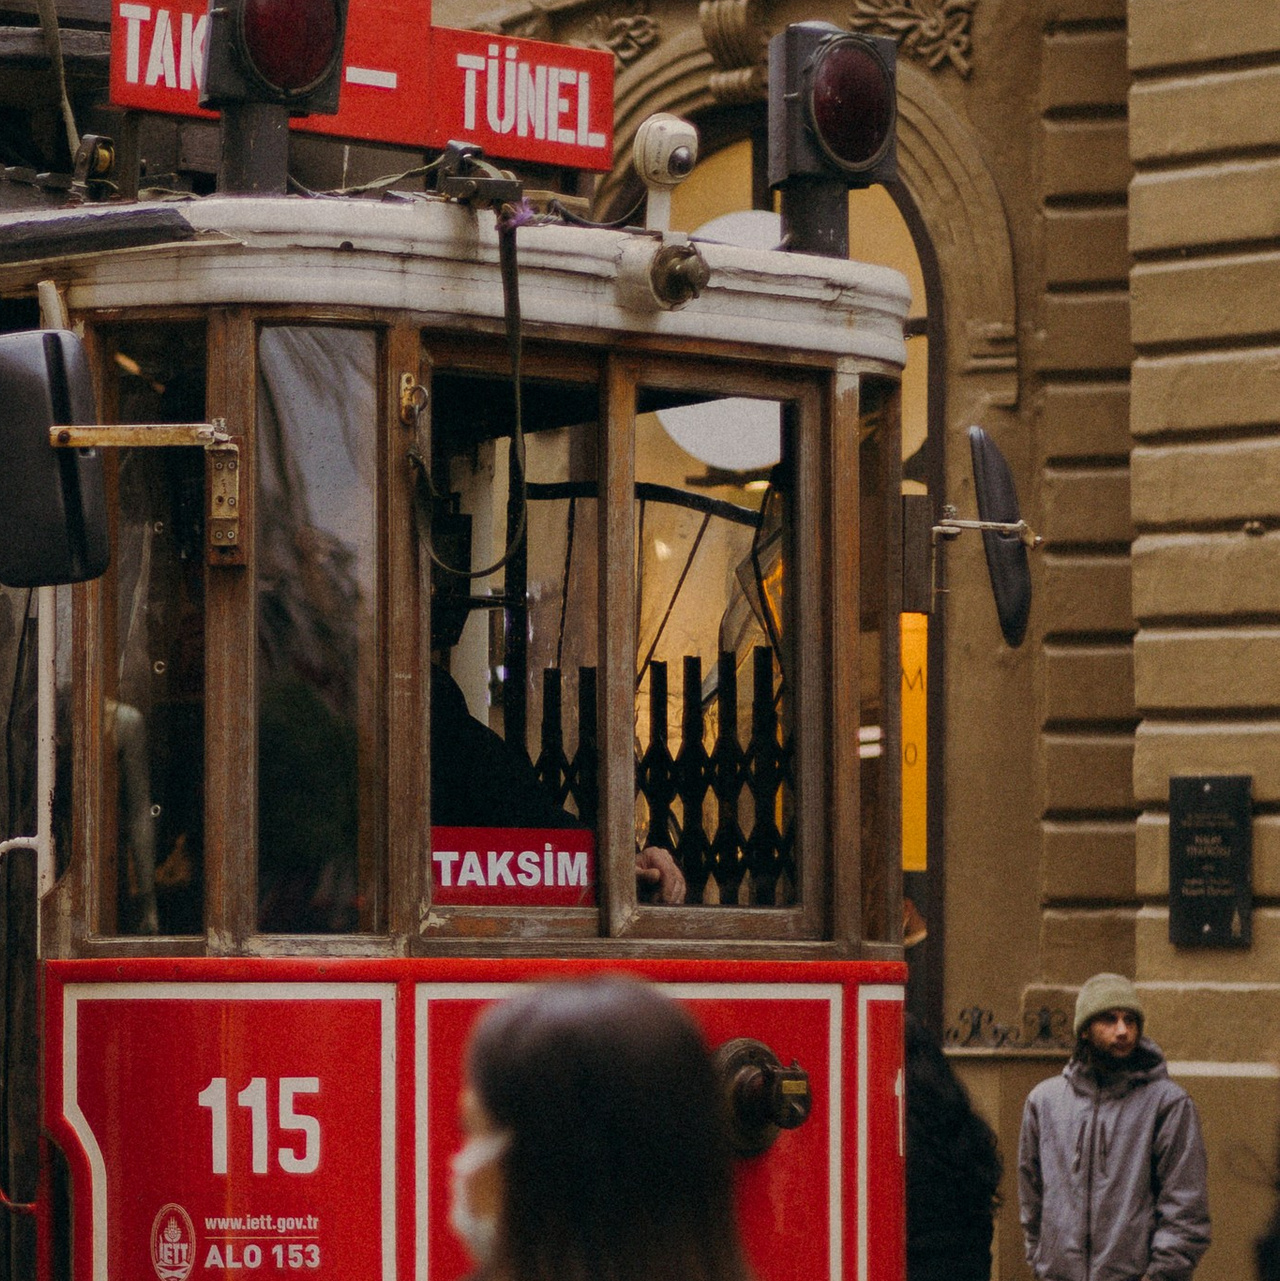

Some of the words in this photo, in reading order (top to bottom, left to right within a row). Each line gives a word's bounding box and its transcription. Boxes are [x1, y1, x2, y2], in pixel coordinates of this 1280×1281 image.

[119, 4, 210, 91] TAK
[456, 43, 607, 149] TÜNEL
[432, 842, 588, 886] TAKSİM
[198, 1077, 320, 1174] 115
[204, 1214, 320, 1233] www.iett.gov.tr
[204, 1243, 263, 1269] ALO
[271, 1243, 321, 1269] 153
